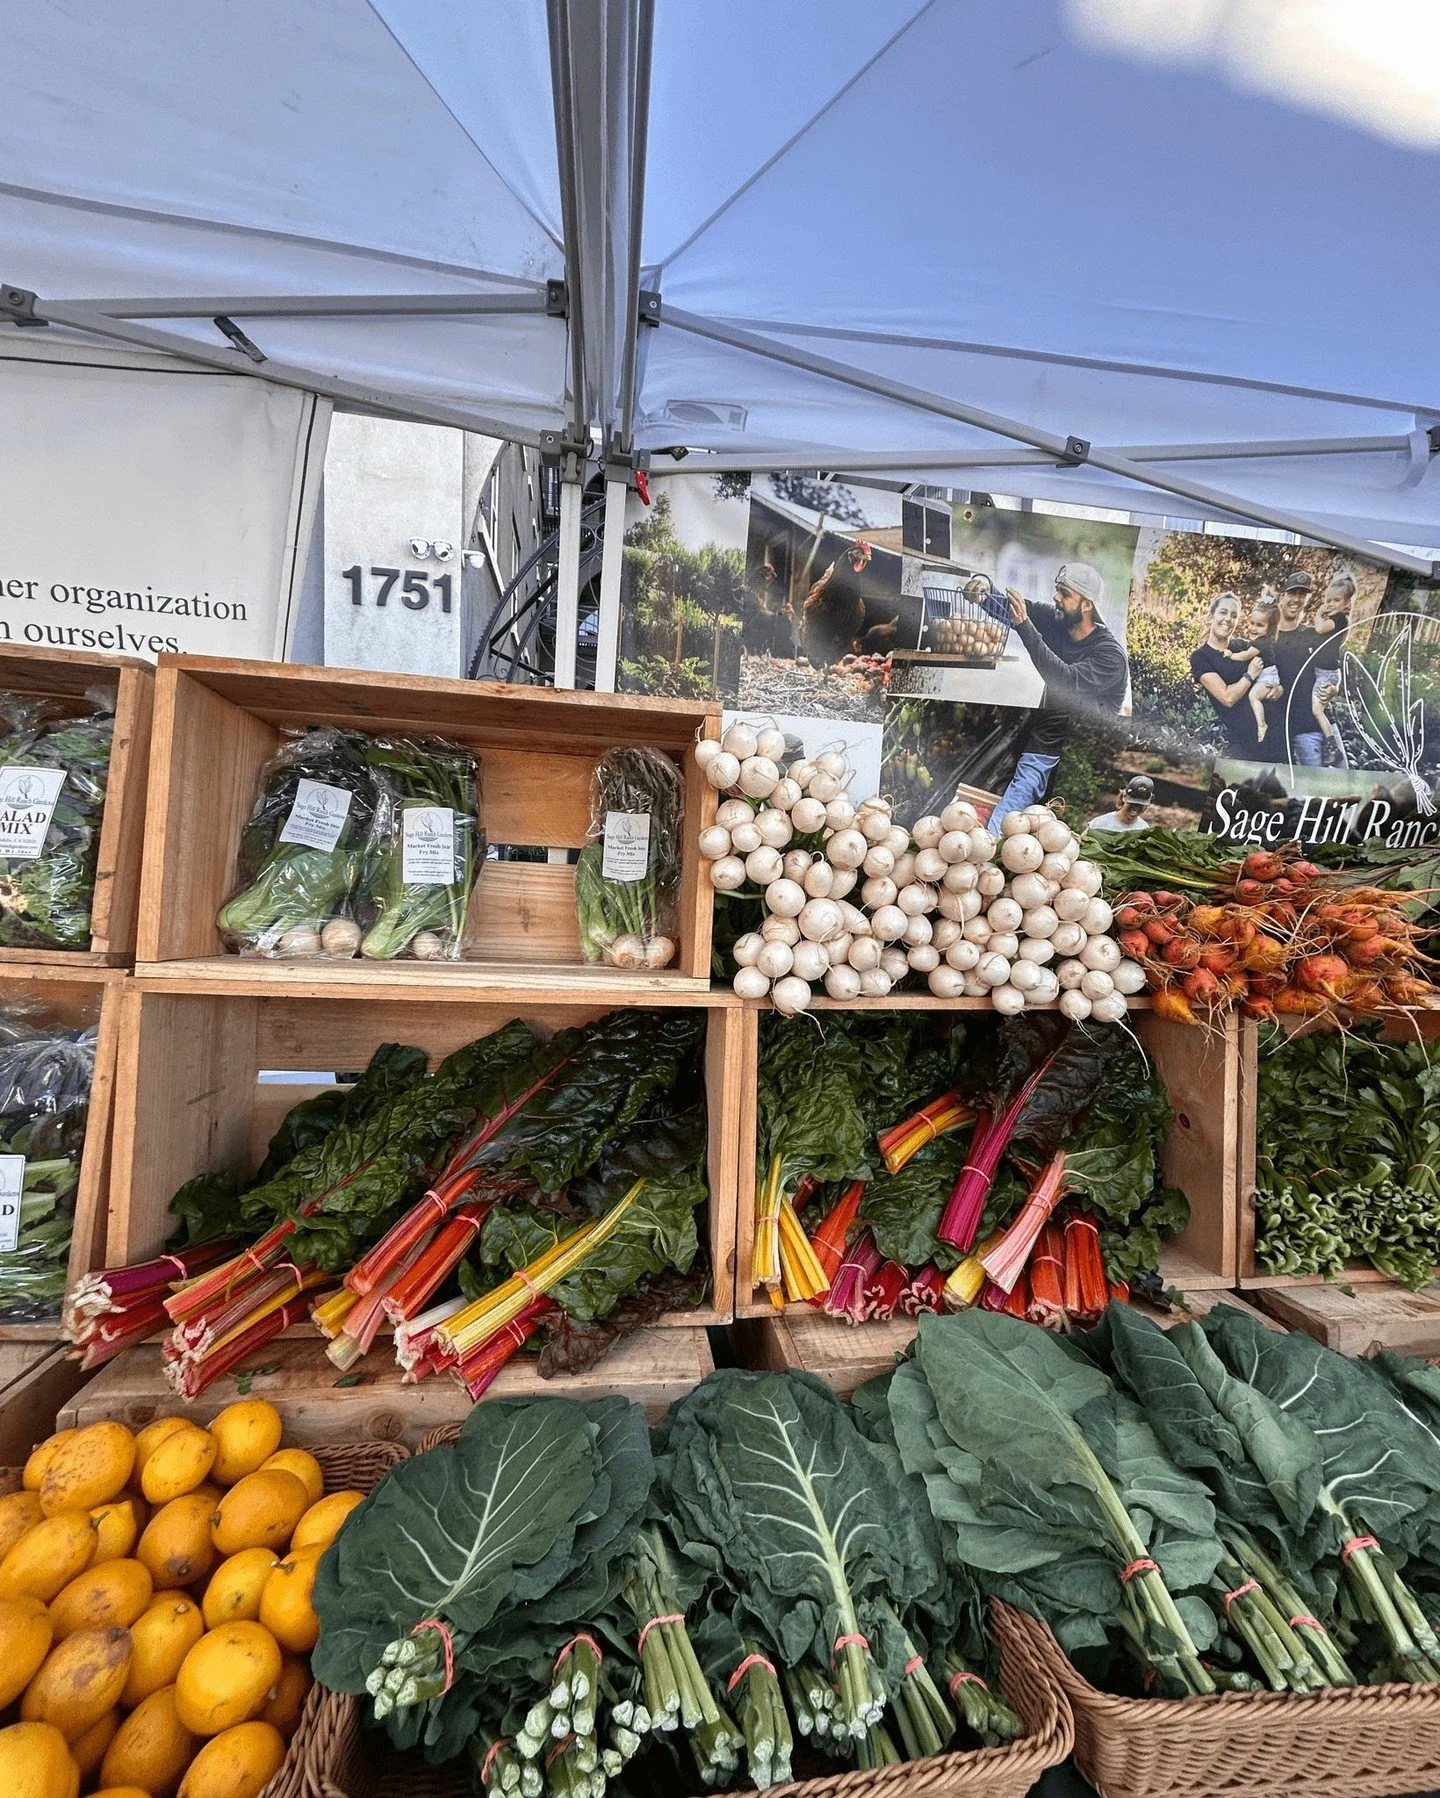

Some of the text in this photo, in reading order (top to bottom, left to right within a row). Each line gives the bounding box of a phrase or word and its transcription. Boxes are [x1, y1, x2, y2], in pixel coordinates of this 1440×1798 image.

[0, 578, 248, 620] er organization
[342, 565, 452, 613] 1751
[24, 624, 187, 654] ourselves.
[1207, 788, 1440, 849] Sage Hill Ranc
